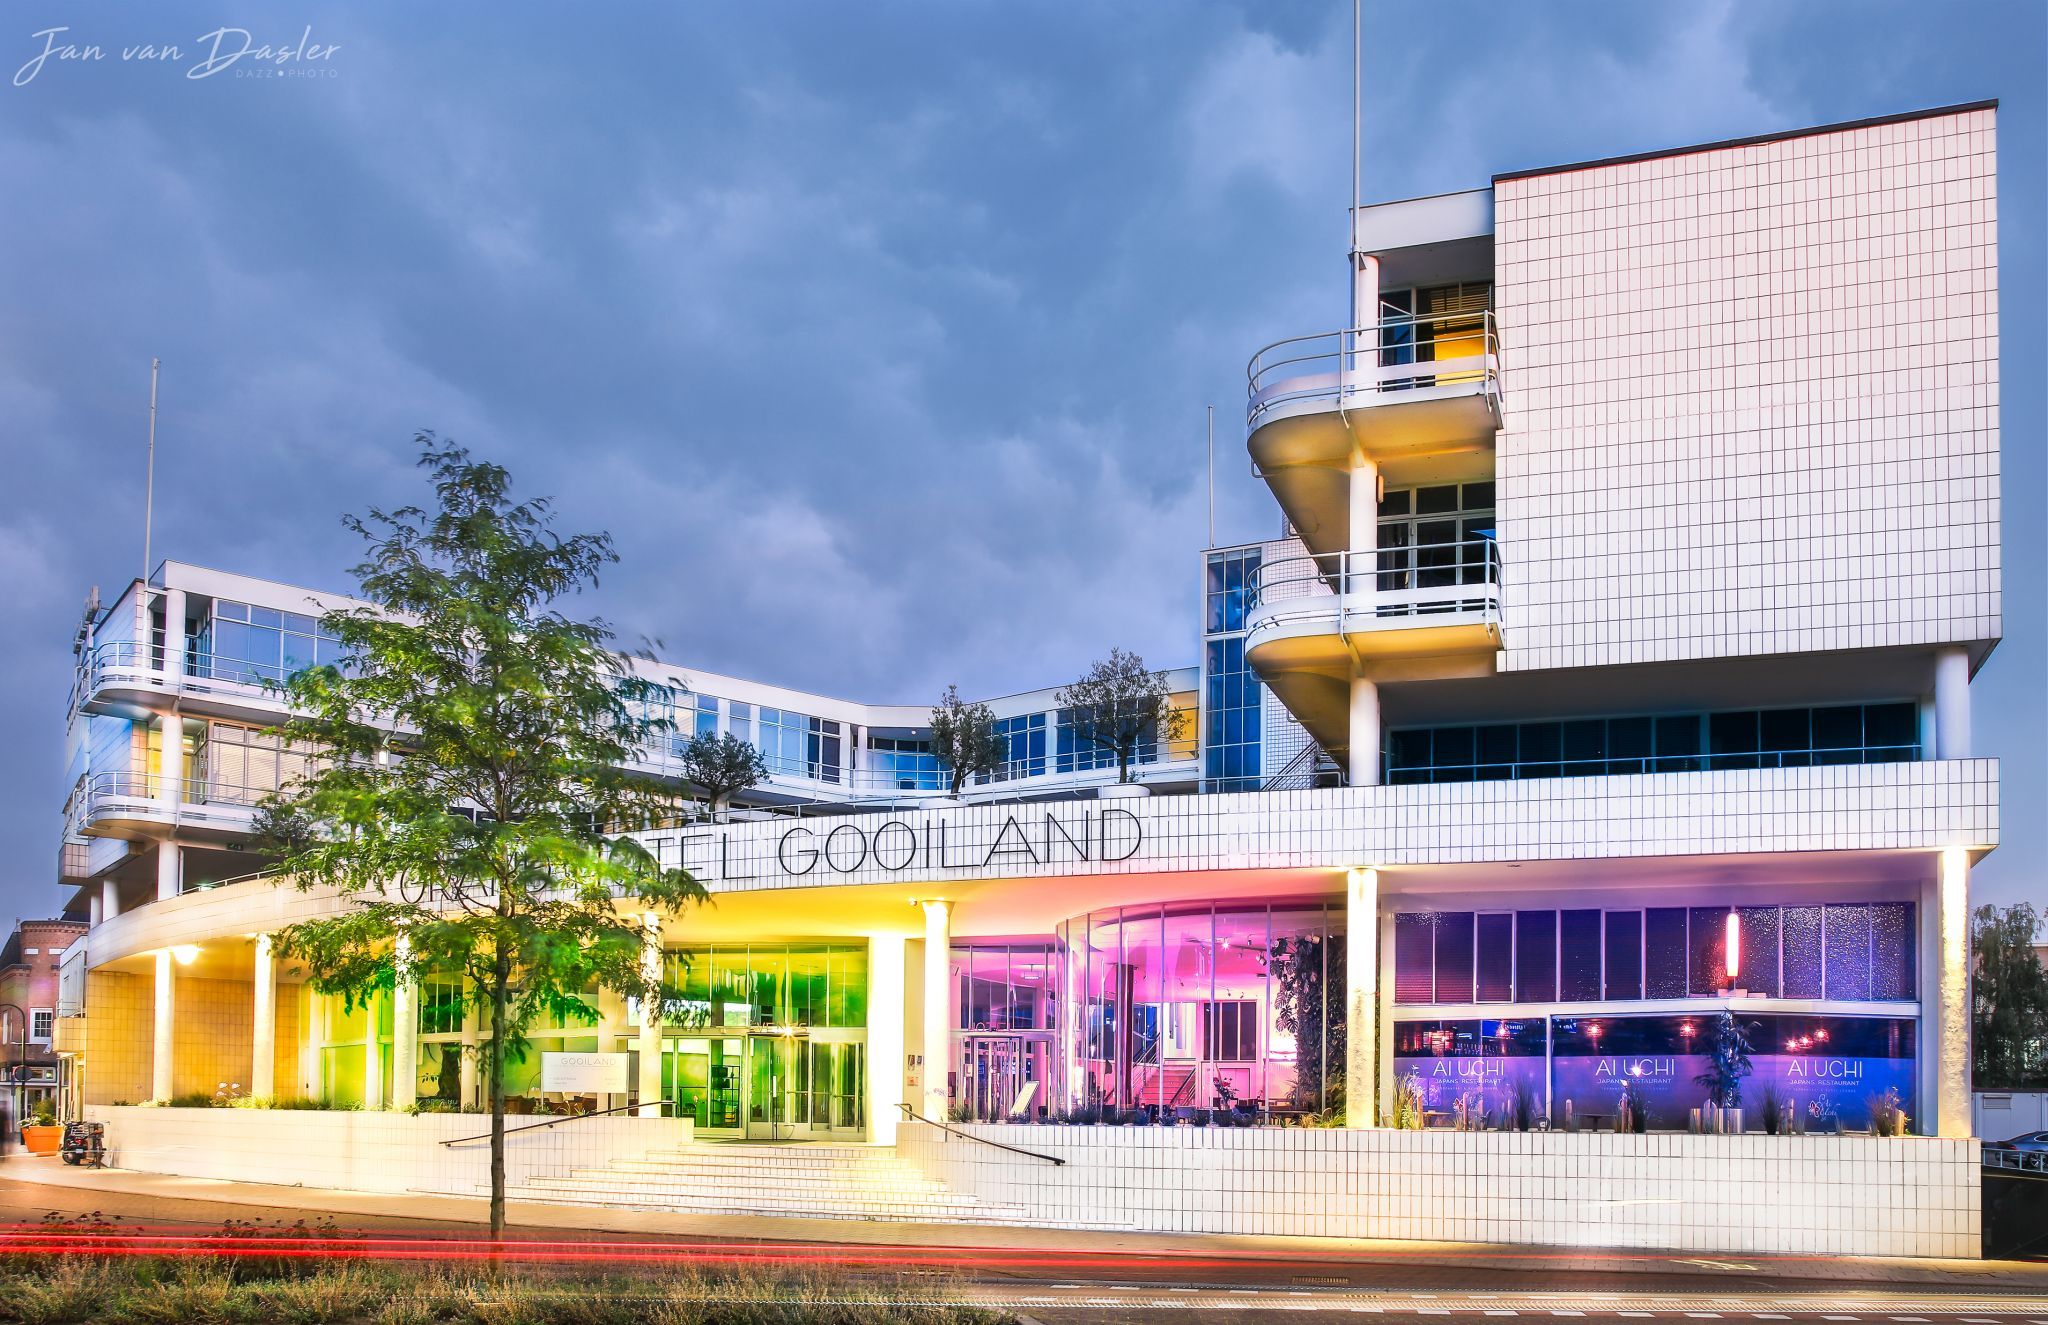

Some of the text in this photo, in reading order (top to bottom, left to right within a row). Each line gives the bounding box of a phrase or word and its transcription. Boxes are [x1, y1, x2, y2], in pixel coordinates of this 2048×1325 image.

[778, 808, 1143, 876] GOOILAND
[561, 1057, 616, 1066] GOOILAND
[1432, 1059, 1504, 1077] AI UCHI
[1595, 1058, 1675, 1077] AI UCHI
[1787, 1059, 1862, 1078] AI UCHI
